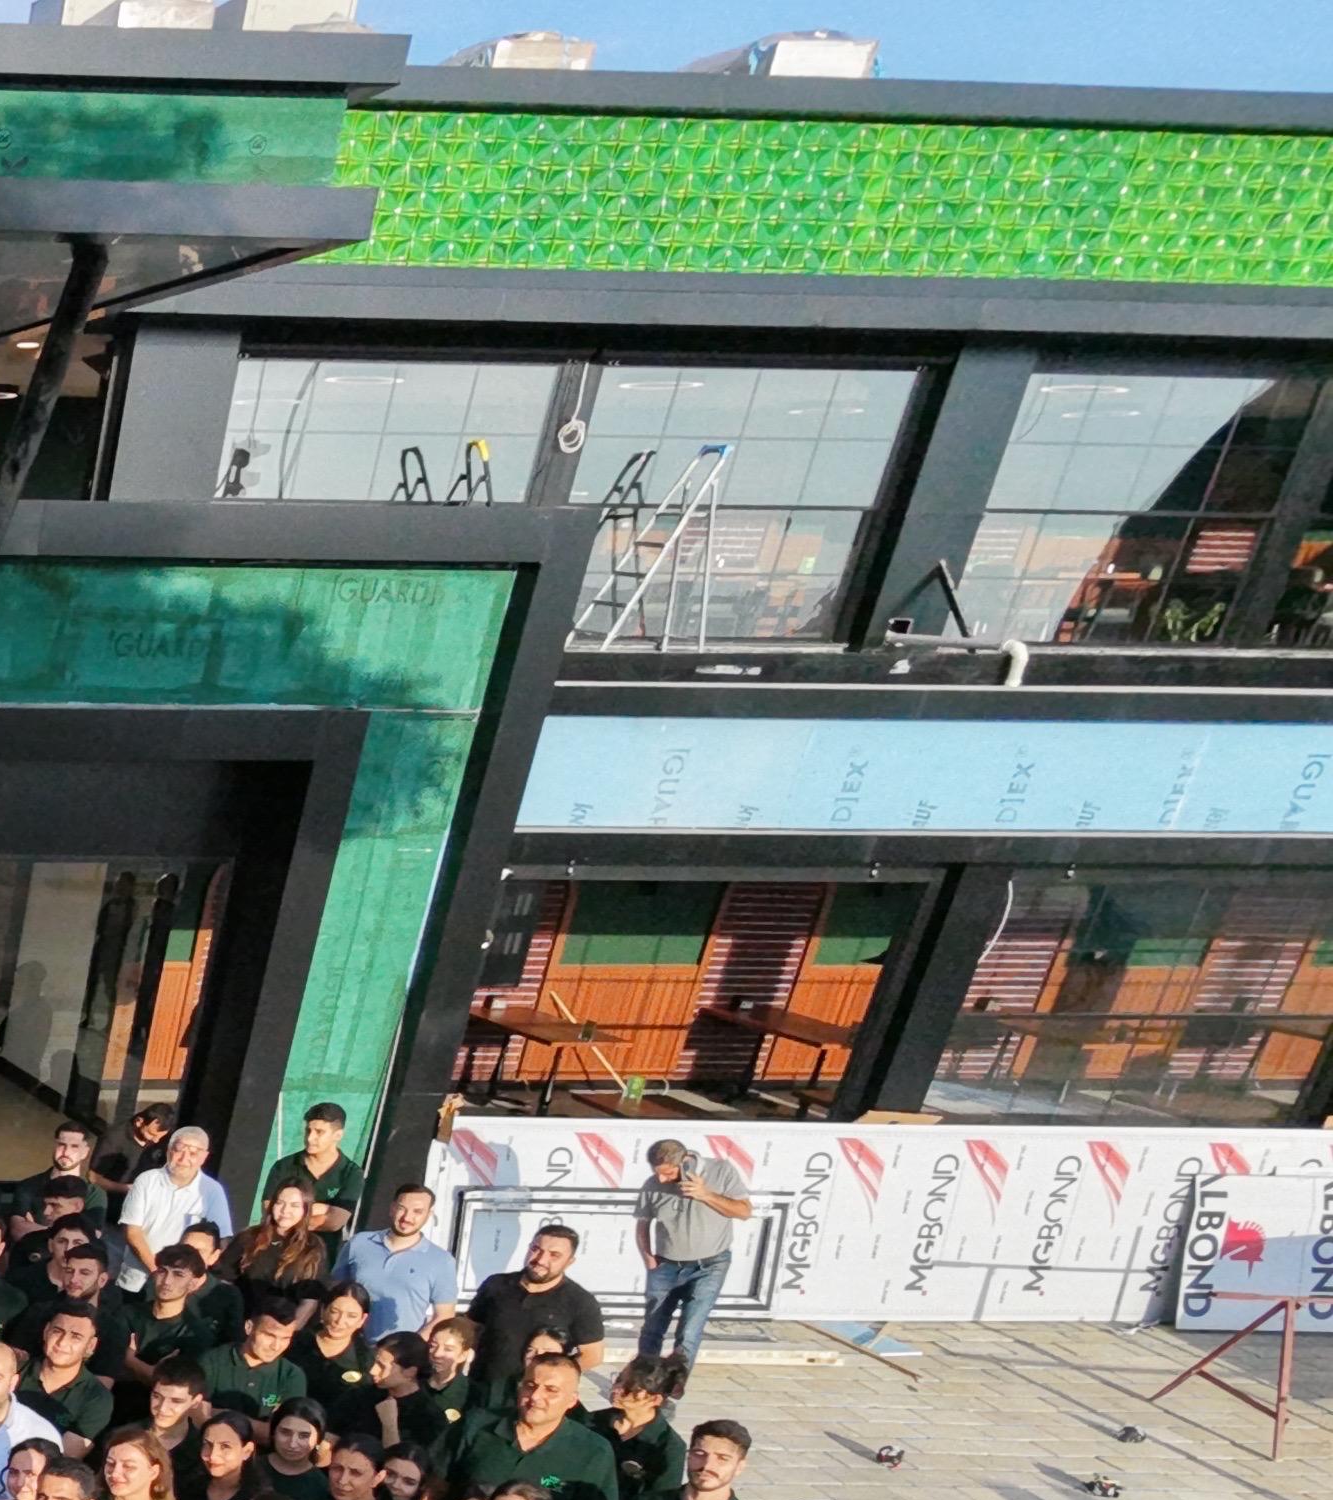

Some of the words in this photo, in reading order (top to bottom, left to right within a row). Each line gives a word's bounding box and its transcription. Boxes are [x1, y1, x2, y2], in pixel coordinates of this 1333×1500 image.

[782, 1152, 834, 1290] MGBOND
[904, 1154, 960, 1291] MGBOND
[1022, 1155, 1082, 1291] MGBOND
